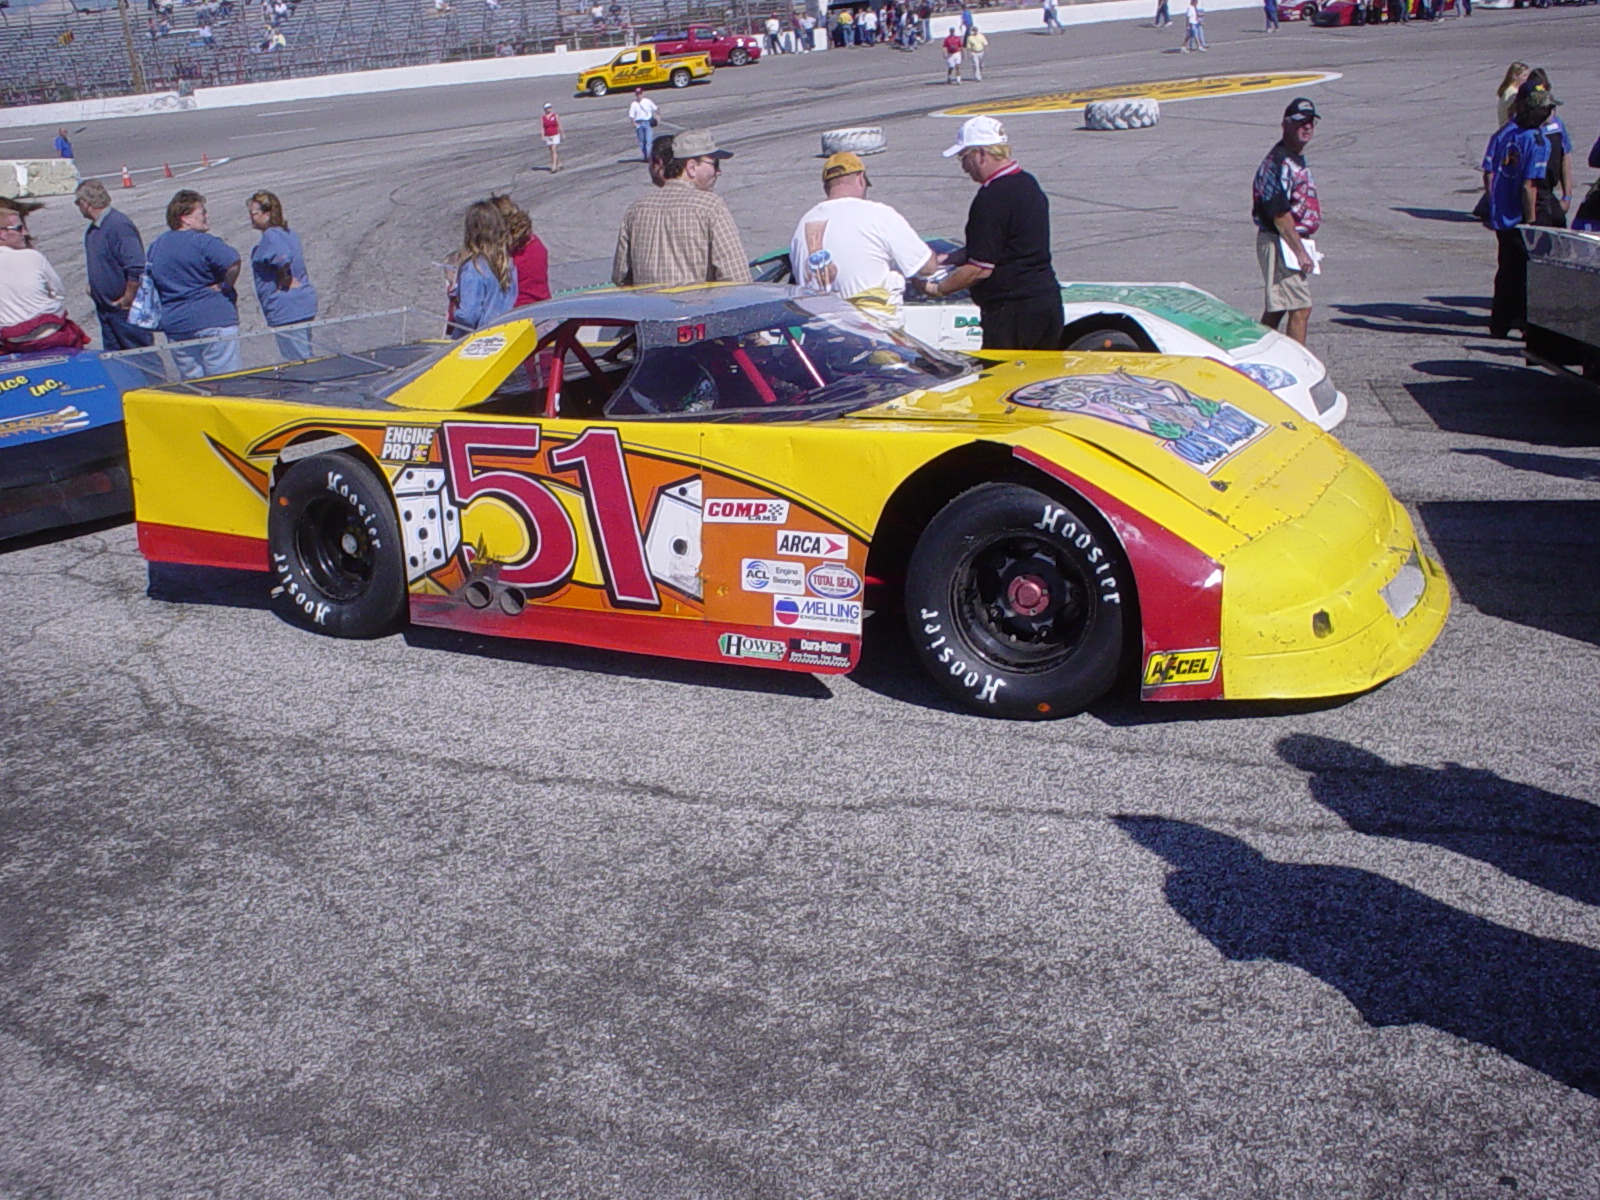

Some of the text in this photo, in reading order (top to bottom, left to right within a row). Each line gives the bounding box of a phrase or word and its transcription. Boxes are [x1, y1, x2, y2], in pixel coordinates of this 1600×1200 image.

[677, 324, 706, 344] 51
[0, 376, 28, 391] ice
[385, 427, 434, 445] ENGINE
[381, 443, 411, 460] PRO
[442, 420, 660, 611] 51
[708, 502, 768, 518] COMP
[748, 514, 778, 522] CAMS
[779, 534, 821, 555] ARCA
[746, 569, 770, 580] ACL
[775, 566, 799, 576] Engine
[812, 574, 855, 589] TOTAL SEAL
[800, 600, 860, 619] MELLING
[1151, 653, 1210, 681] ACCEL
